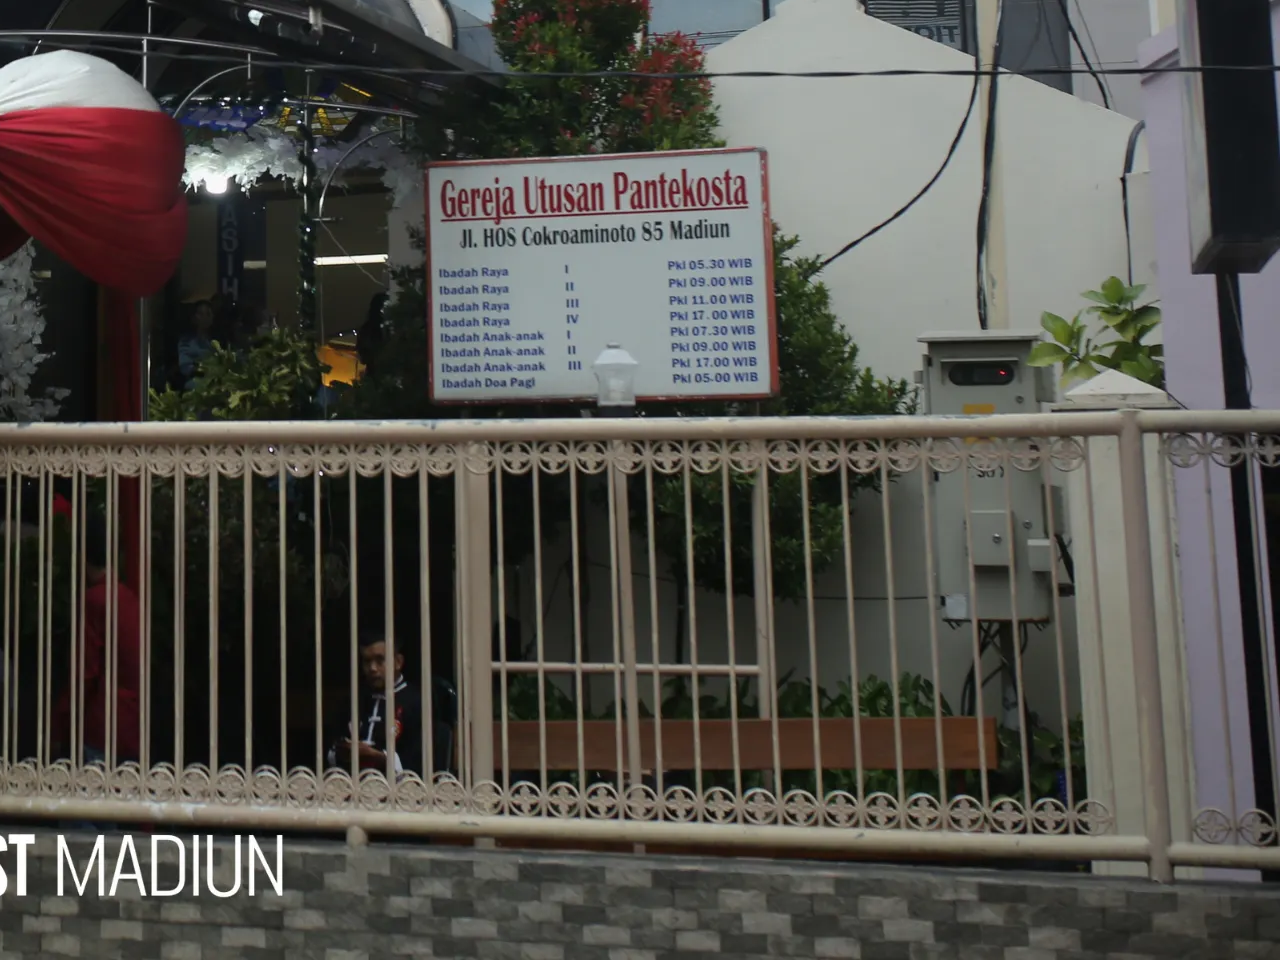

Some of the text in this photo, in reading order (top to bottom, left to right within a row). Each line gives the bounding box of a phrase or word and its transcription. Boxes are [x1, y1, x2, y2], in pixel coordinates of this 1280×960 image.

[441, 168, 748, 225] Gereja Utusan Pantekosta
[484, 227, 516, 247] HOS
[522, 225, 635, 246] Cokroaminoto
[670, 220, 730, 240] Madiun
[439, 268, 478, 277] Ibadah
[482, 268, 508, 277] Raya
[668, 261, 686, 270] Pkl
[689, 259, 724, 270] 05.30
[728, 258, 752, 268] WIB
[440, 276, 753, 295] Ibadah Raya II Pkl 09.00 WIB
[440, 294, 754, 313] Ibadah Raya III Pkl 11.00 WIB
[440, 318, 479, 327] Ibadah
[483, 317, 510, 328] Raya
[567, 314, 579, 324] IV
[670, 312, 688, 321] Pkl
[730, 310, 754, 319] WIB
[441, 333, 479, 342] Ibadah
[483, 332, 544, 341] Anak-anak
[671, 327, 688, 336] Pkl
[692, 326, 728, 336] 07.30
[731, 325, 755, 335] WIB
[441, 341, 756, 357] Ibadah Anak-anak II Pkl 09.00 WIB
[442, 357, 757, 372] Ibadah Anak-anak III Pkl 17.00 WIB
[442, 379, 481, 388] Ibadah
[485, 379, 506, 387] Doa
[510, 378, 535, 389] Pagi
[673, 374, 691, 383] Pkl
[734, 372, 758, 382] WIB
